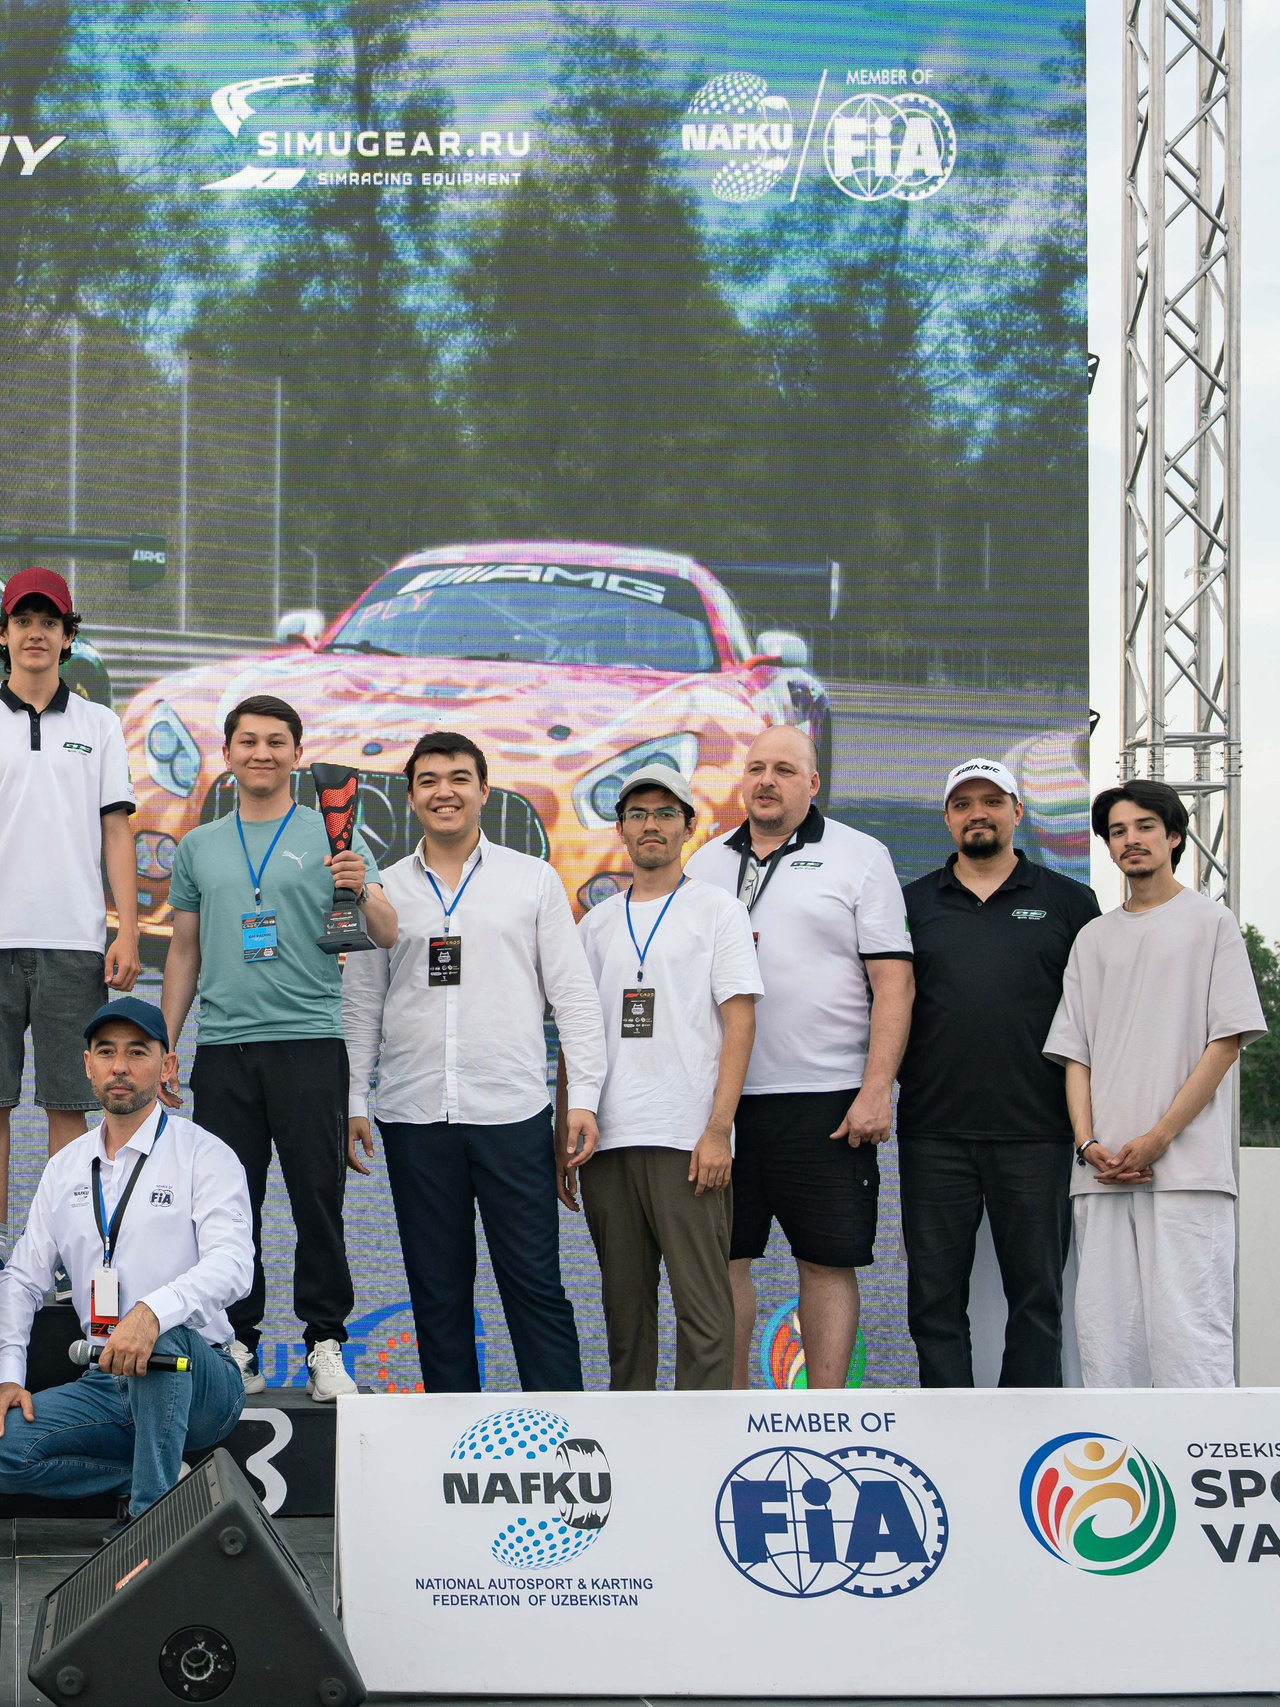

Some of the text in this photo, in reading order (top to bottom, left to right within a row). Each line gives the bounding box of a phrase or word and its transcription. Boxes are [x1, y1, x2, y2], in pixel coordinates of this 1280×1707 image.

[846, 69, 934, 85] MEMBER OF
[257, 131, 530, 157] SIMUGEAR.RU
[681, 123, 793, 151] NAFKU
[318, 172, 521, 186] SIMRACING EQUIPMENT
[956, 764, 1001, 777] SIMAGIC
[746, 1412, 896, 1433] MEMBER OF
[442, 1471, 612, 1504] NAFKU
[415, 1578, 653, 1590] NATIONAL AUTOSPORT & KARTING
[432, 1594, 638, 1606] FEDERATION OF UZBEKISTAN
